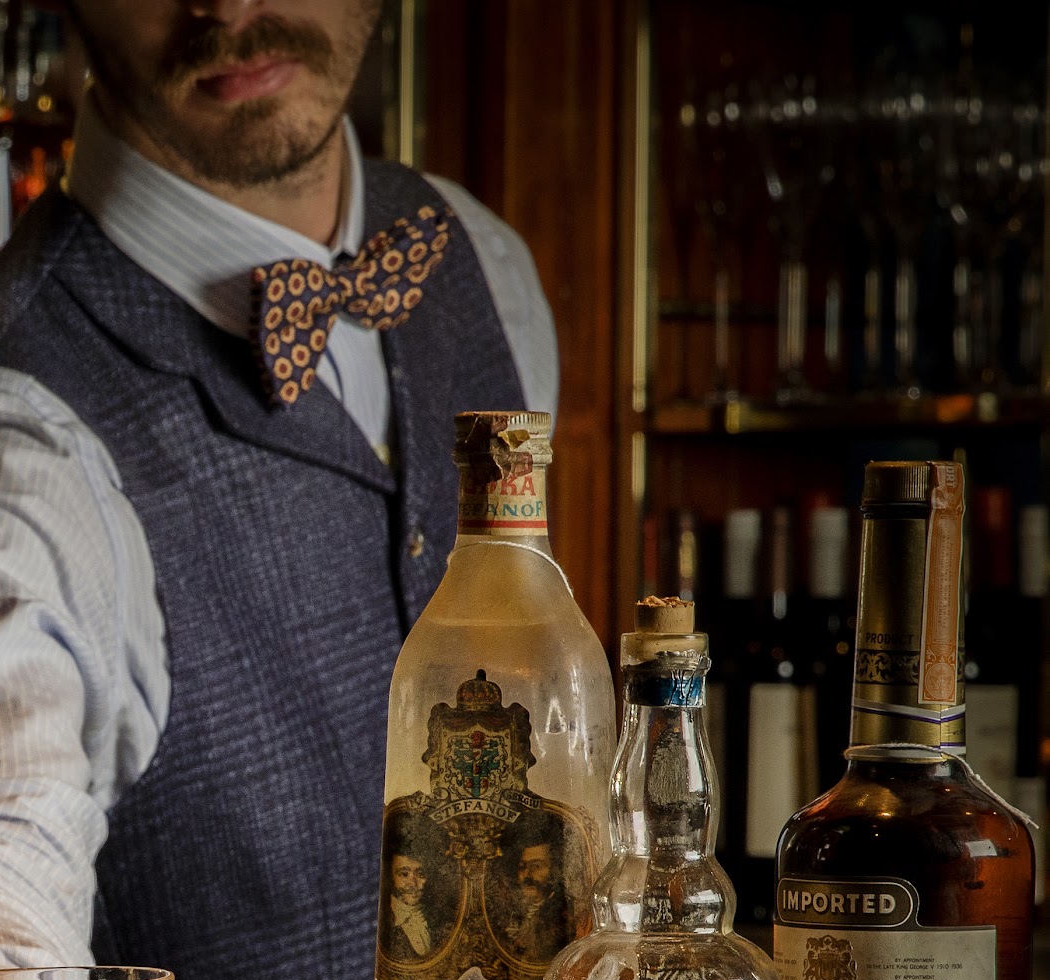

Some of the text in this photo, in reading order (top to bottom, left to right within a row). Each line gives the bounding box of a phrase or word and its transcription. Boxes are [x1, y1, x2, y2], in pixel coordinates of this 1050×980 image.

[866, 632, 913, 645] PRODUCT
[431, 801, 518, 821] STEFANOF
[782, 889, 896, 915] IMPORTED
